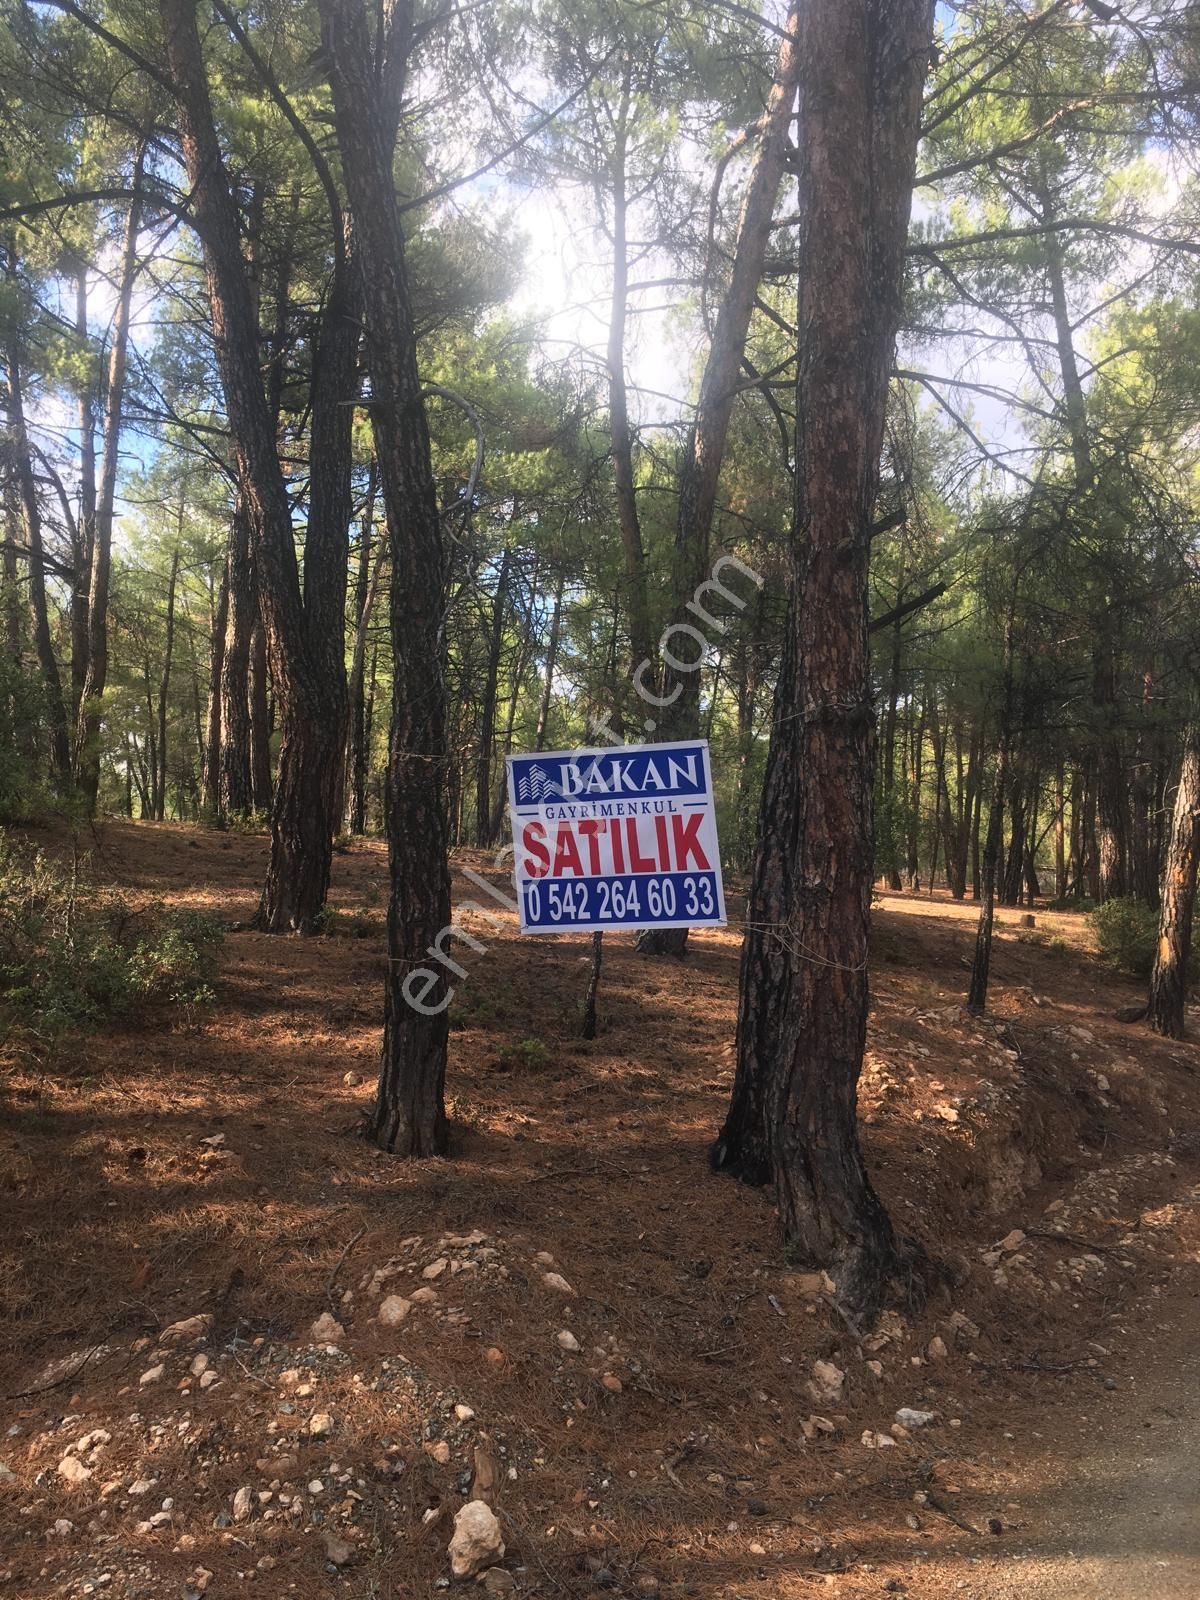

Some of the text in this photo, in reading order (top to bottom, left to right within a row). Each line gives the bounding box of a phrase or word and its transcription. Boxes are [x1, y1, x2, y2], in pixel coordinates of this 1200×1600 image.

[558, 754, 699, 796] BAKAN
[545, 800, 678, 819] GAYRİMENKUL
[522, 813, 711, 878] SATILIK
[528, 876, 714, 922] 0 542 264 60 33
